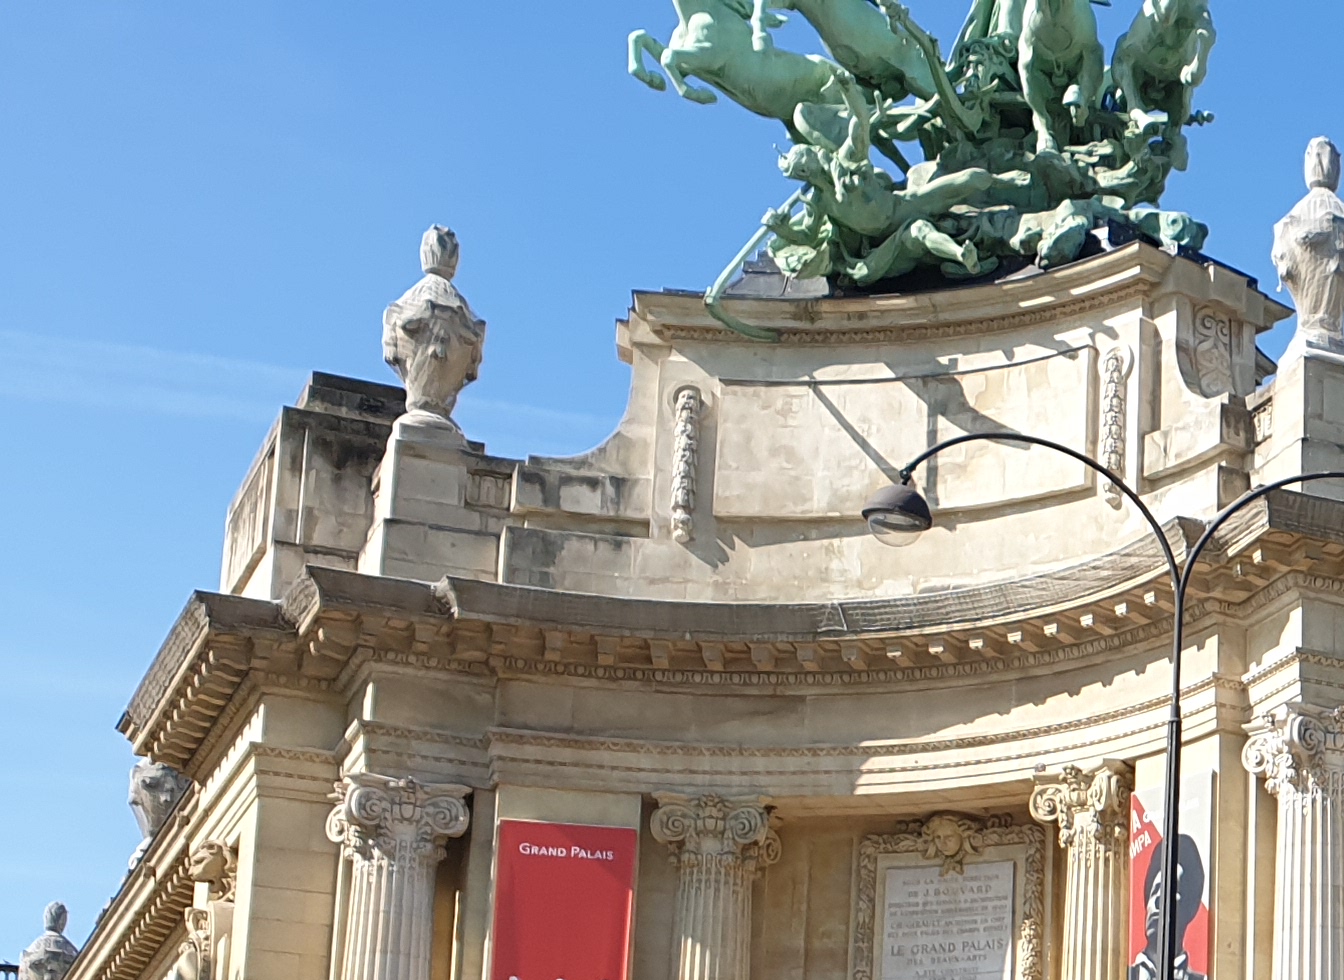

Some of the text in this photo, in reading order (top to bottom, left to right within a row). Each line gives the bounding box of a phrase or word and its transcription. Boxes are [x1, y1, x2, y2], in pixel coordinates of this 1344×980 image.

[519, 842, 614, 860] GRAND PALAIS
[891, 939, 1004, 956] LE GRAND PALAIS
